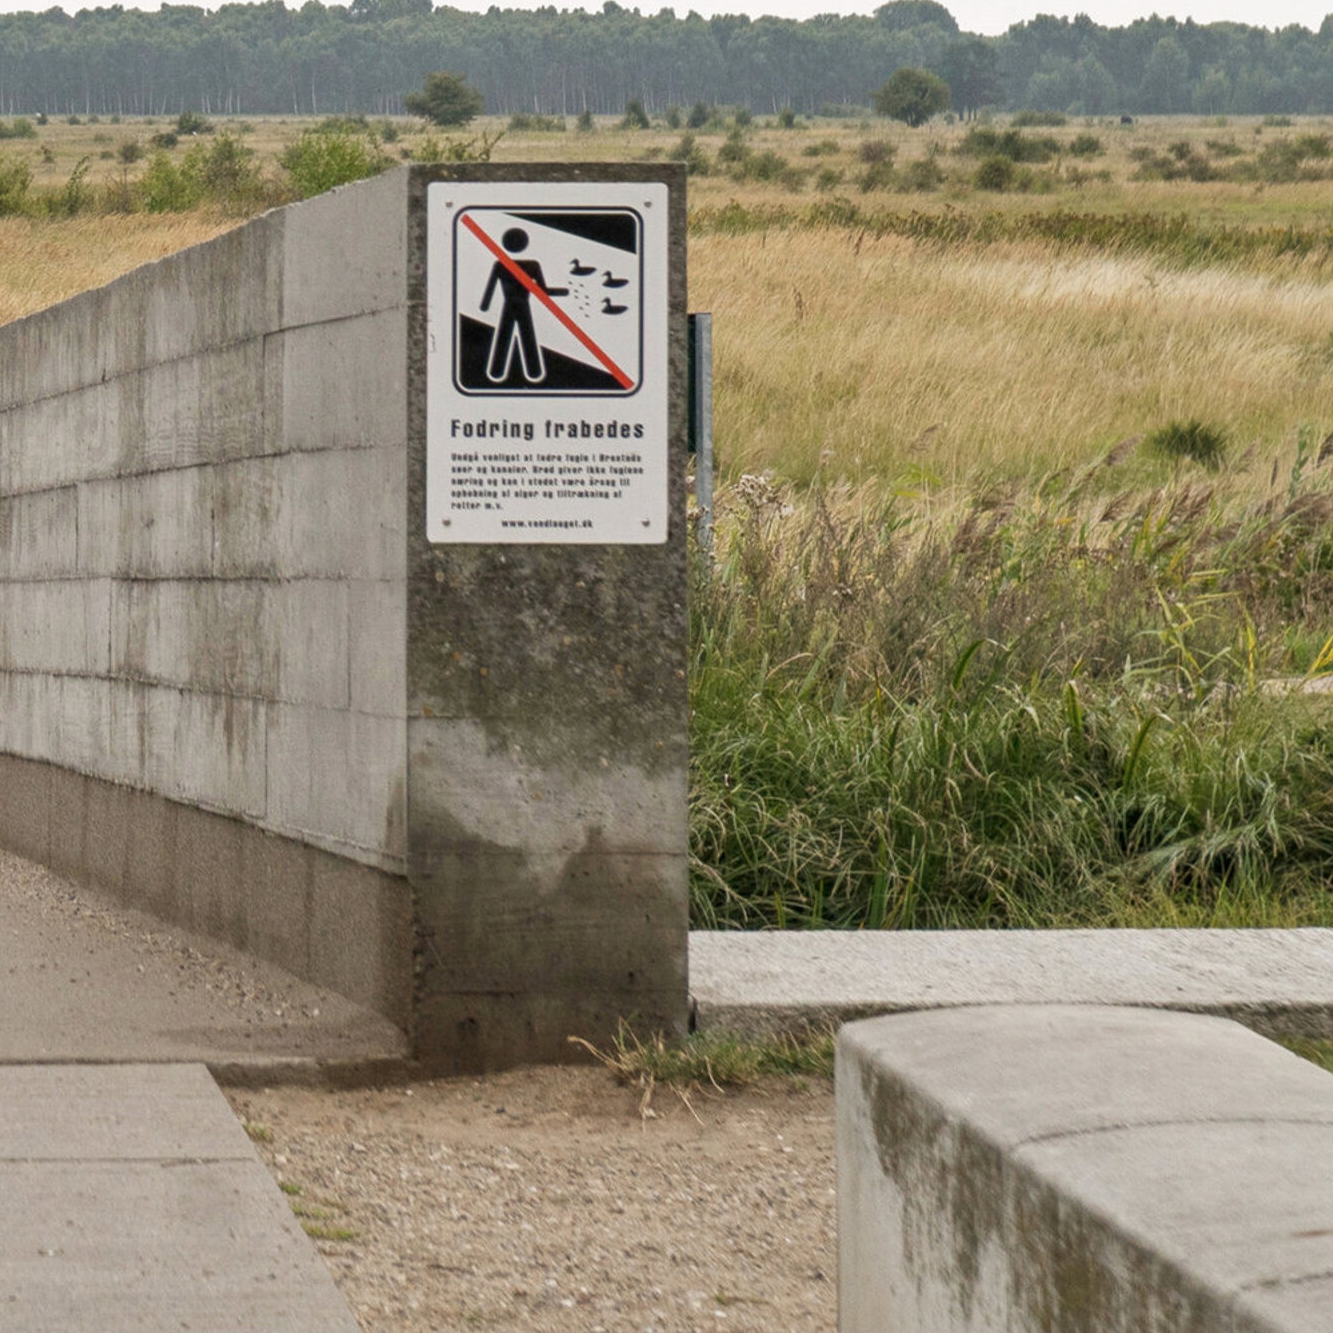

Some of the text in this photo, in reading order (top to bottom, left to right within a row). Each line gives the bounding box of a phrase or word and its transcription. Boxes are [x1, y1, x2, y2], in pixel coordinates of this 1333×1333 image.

[451, 419, 645, 441] Fodring frabedes
[523, 454, 533, 462] at
[476, 466, 487, 475] og
[487, 478, 498, 487] og
[542, 491, 553, 499] og
